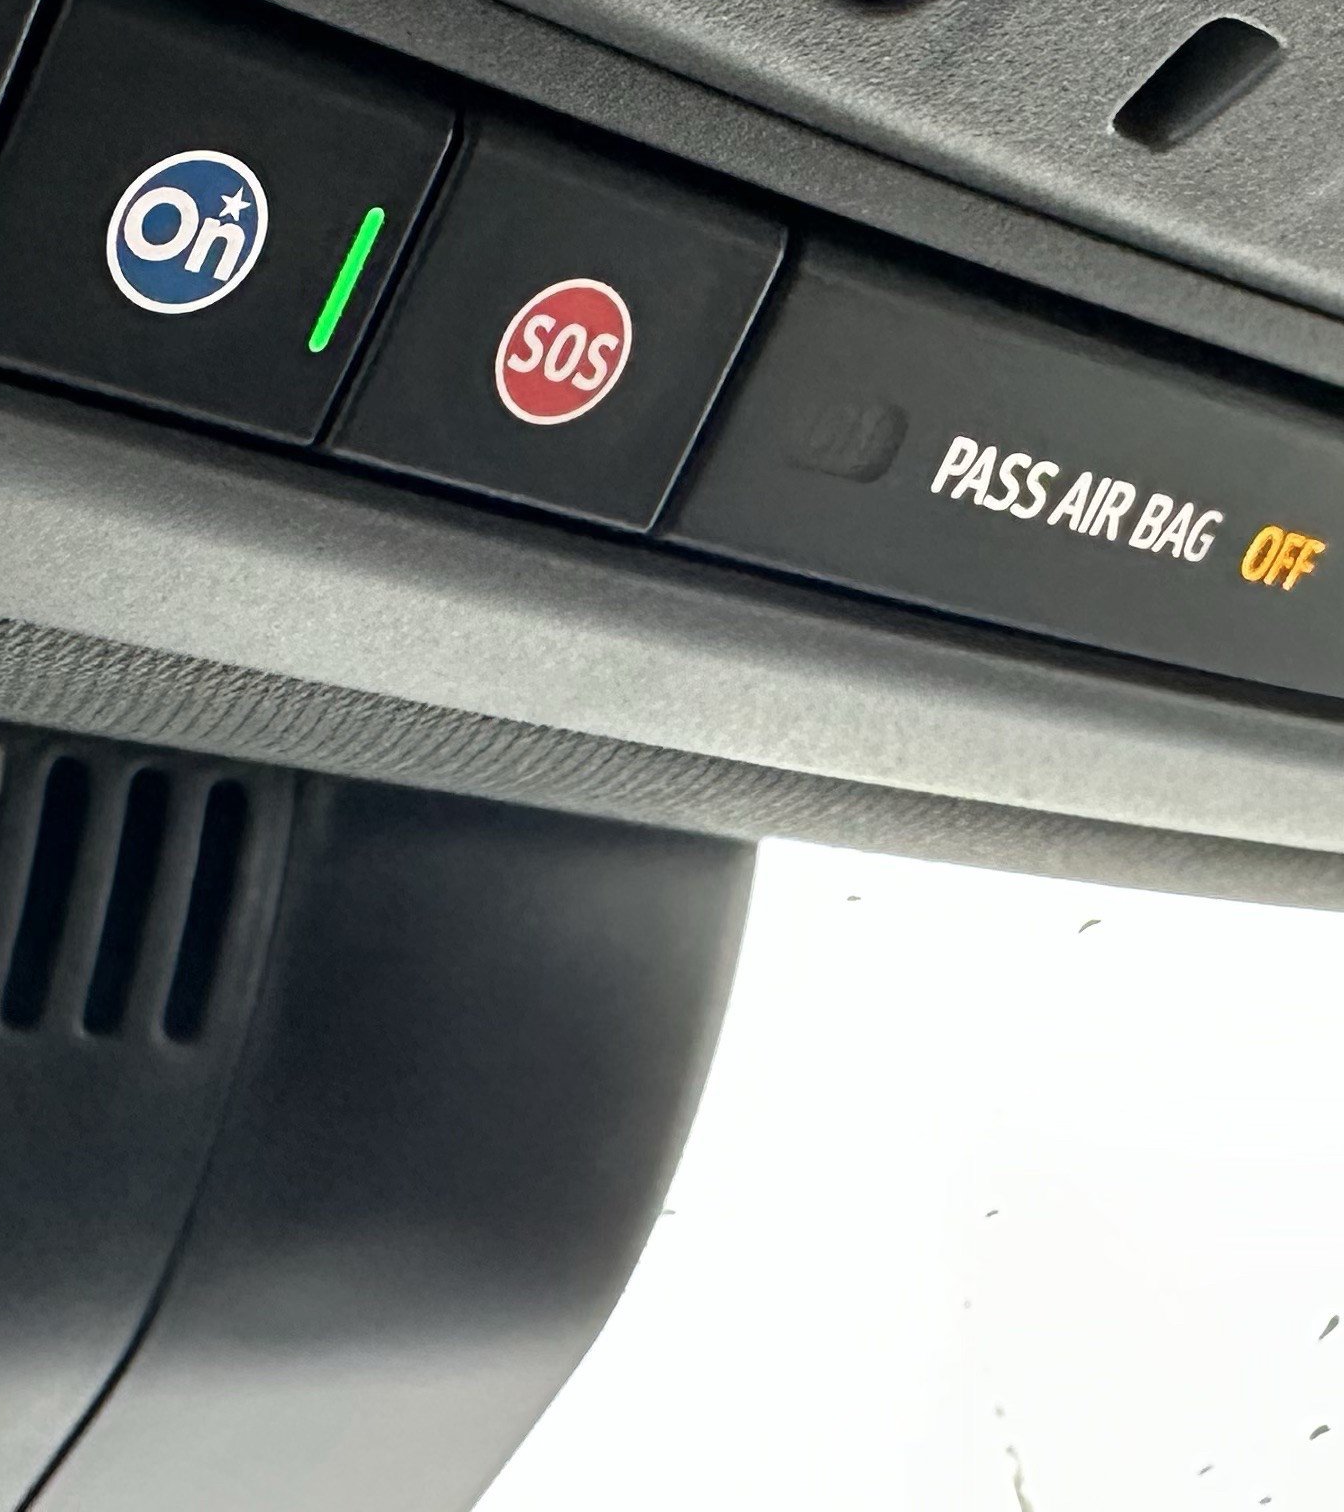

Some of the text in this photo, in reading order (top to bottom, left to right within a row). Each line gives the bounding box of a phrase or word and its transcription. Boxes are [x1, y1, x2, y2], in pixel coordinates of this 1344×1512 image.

[123, 186, 247, 282] On
[507, 313, 619, 391] SOS
[930, 434, 1327, 591] PASS AIR BAG OFF
